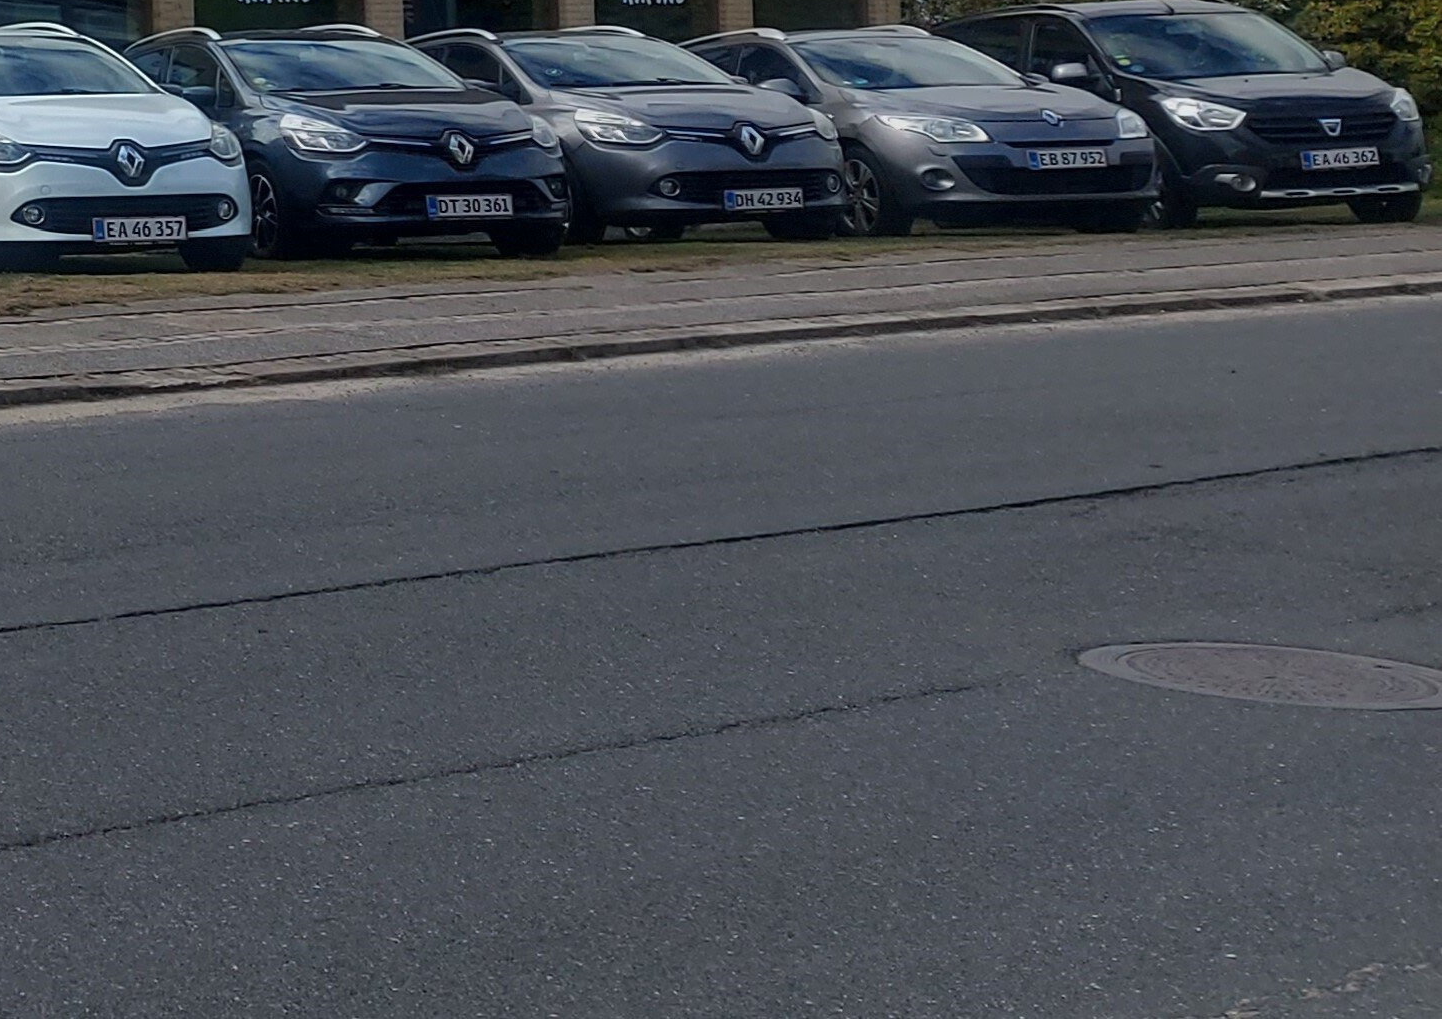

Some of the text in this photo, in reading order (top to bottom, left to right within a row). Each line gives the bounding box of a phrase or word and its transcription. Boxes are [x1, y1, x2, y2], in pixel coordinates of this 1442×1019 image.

[1039, 152, 1059, 166] EB
[1080, 151, 1105, 164] 952
[1313, 153, 1331, 166] EA
[1352, 150, 1378, 164] 362
[438, 197, 510, 213] DT 30 361
[735, 191, 802, 207] DH 42 934
[106, 220, 184, 238] EA 46 357
